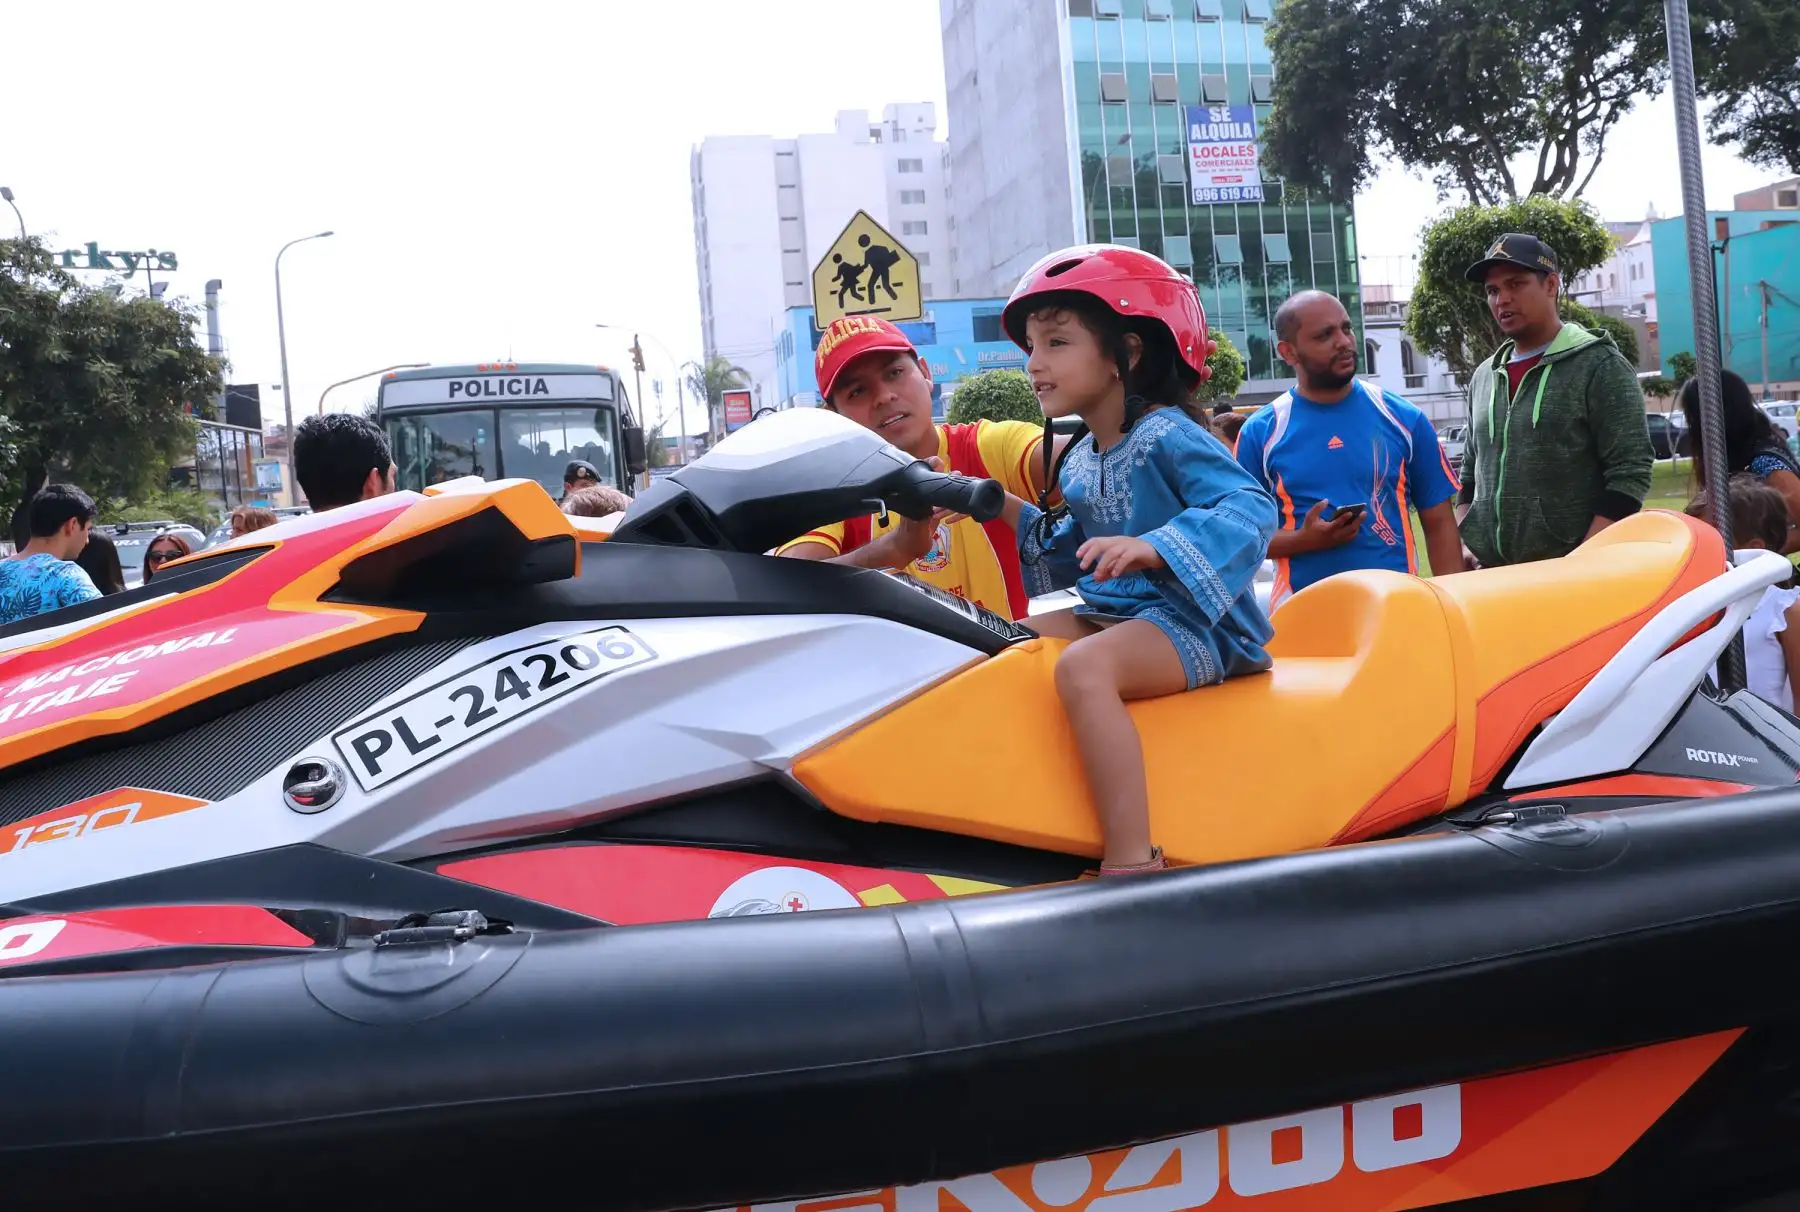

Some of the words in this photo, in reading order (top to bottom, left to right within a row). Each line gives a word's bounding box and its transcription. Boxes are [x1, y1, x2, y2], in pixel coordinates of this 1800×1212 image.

[1208, 106, 1232, 122] SE
[1191, 123, 1253, 141] ALQUILA
[1193, 145, 1254, 158] LOCALES
[1195, 159, 1254, 168] COMERCIALES
[1195, 188, 1218, 201] 996
[1220, 187, 1240, 200] 619
[1242, 187, 1260, 199] 474
[817, 318, 885, 369] POLICIA
[449, 378, 549, 398] POLICIA
[4, 628, 239, 698] NACIONAL
[350, 635, 635, 777] PL-24206
[1685, 747, 1740, 767] ROTAX
[1738, 755, 1759, 764] POWER
[11, 802, 142, 854] 130
